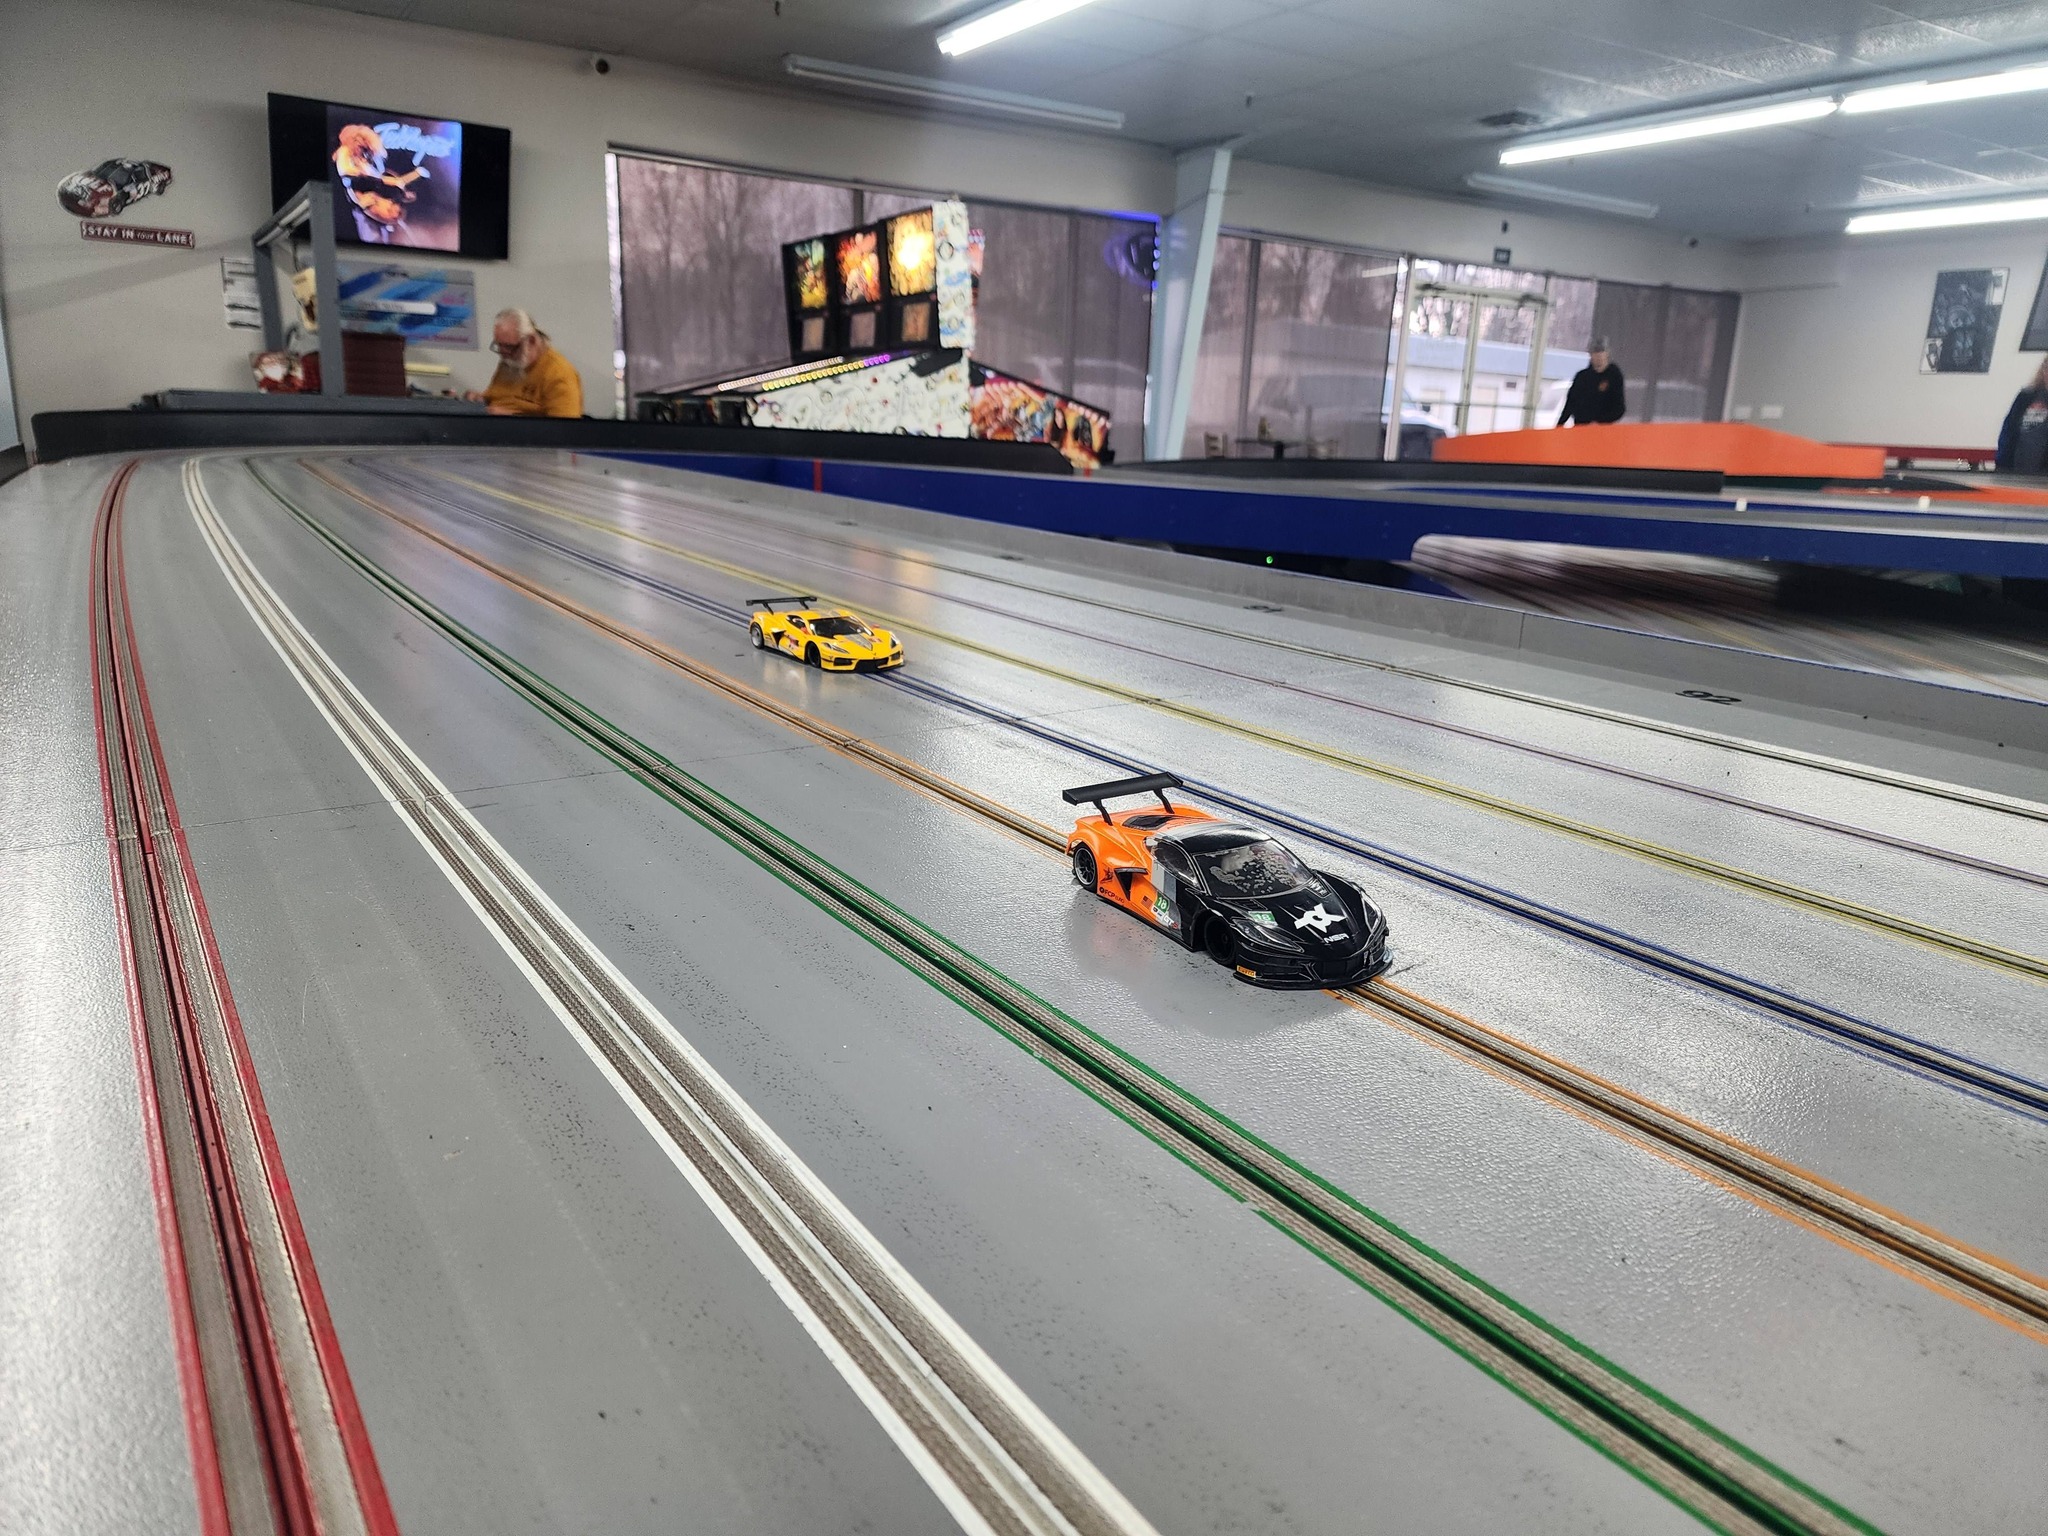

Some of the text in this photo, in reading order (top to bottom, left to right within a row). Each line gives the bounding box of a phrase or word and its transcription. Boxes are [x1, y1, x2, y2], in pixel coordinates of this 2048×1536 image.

[87, 226, 118, 238] STAY
[121, 228, 134, 239] IN
[156, 232, 188, 245] LANE
[1104, 889, 1116, 898] FCP
[1157, 896, 1168, 910] 18
[1254, 913, 1272, 922] 18
